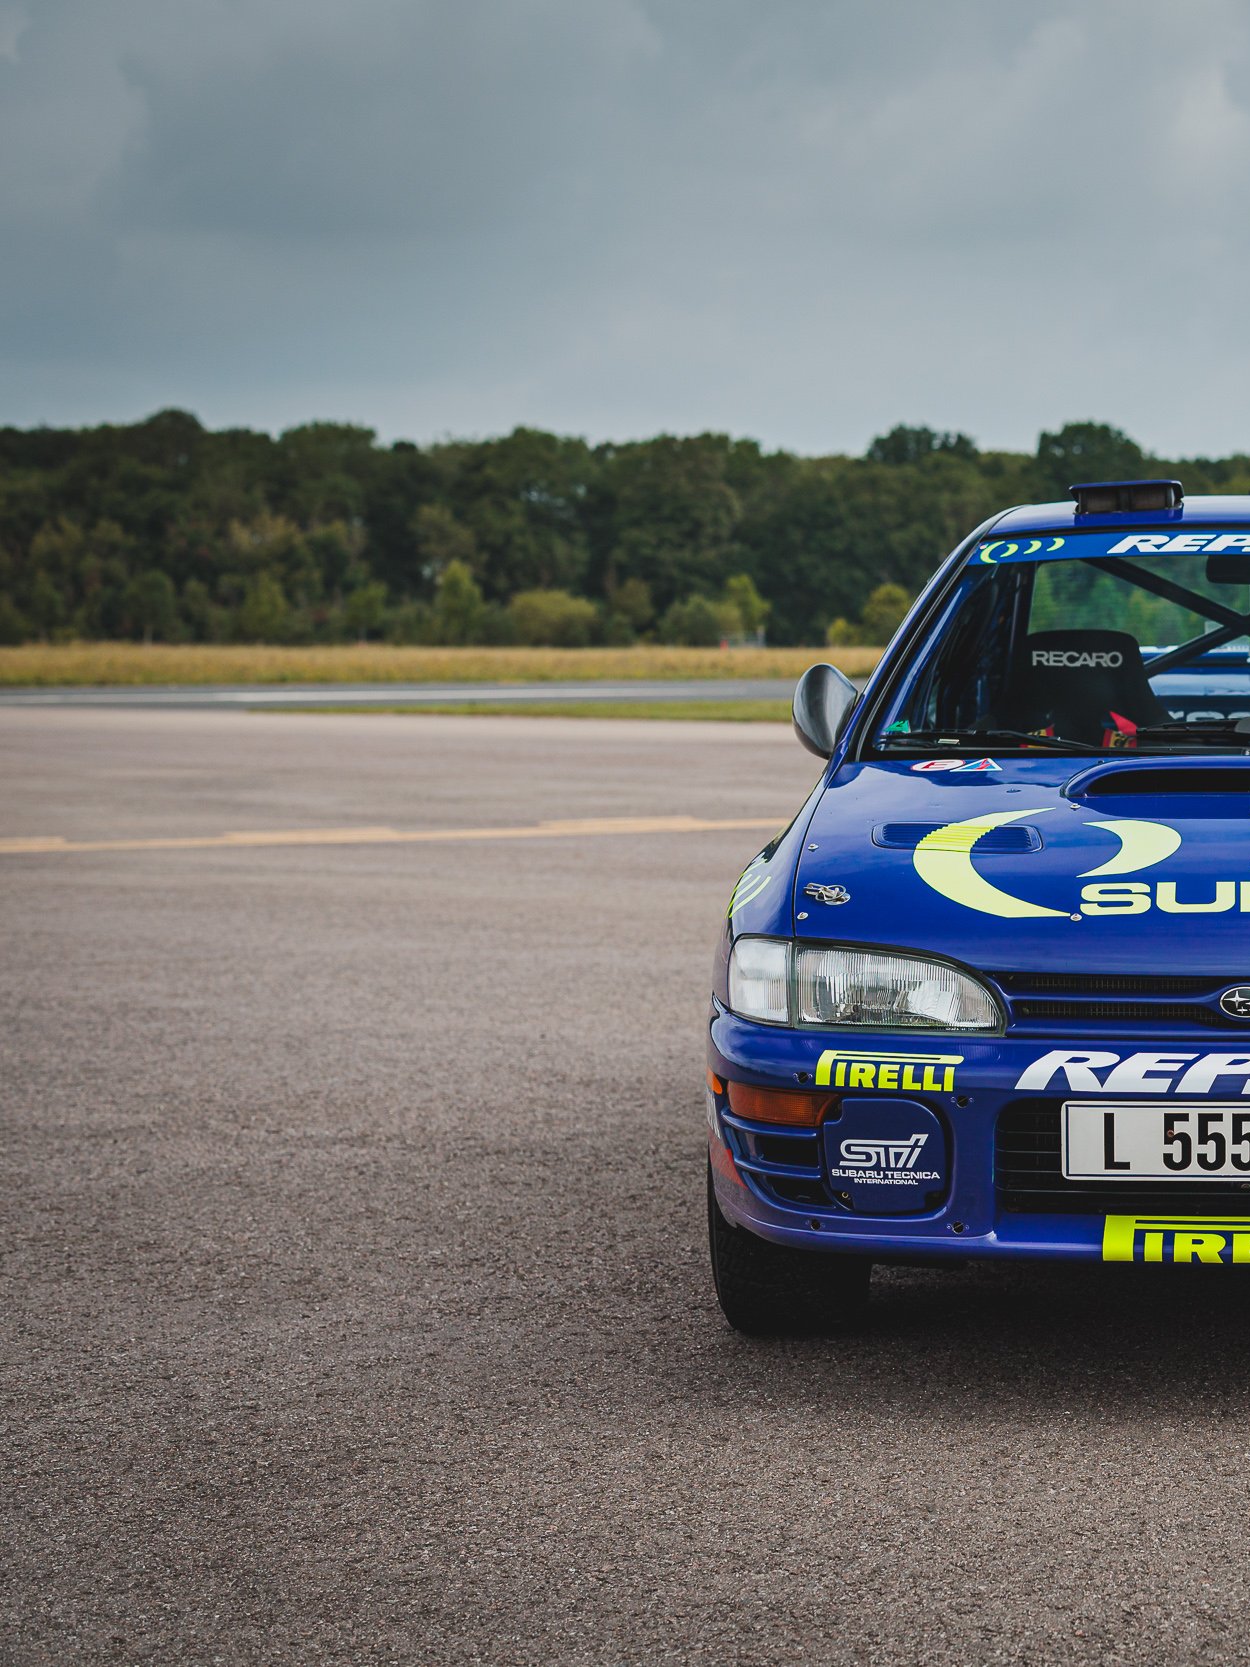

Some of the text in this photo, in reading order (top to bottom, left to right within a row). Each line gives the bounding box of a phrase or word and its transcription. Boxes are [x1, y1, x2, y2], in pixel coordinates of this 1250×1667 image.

[1032, 650, 1123, 667] RECARO
[815, 1049, 964, 1092] PIRELLI
[1103, 1112, 1131, 1170] L
[831, 1168, 941, 1180] SUBARU TECNICA
[853, 1178, 919, 1186] INTERNATIONAL
